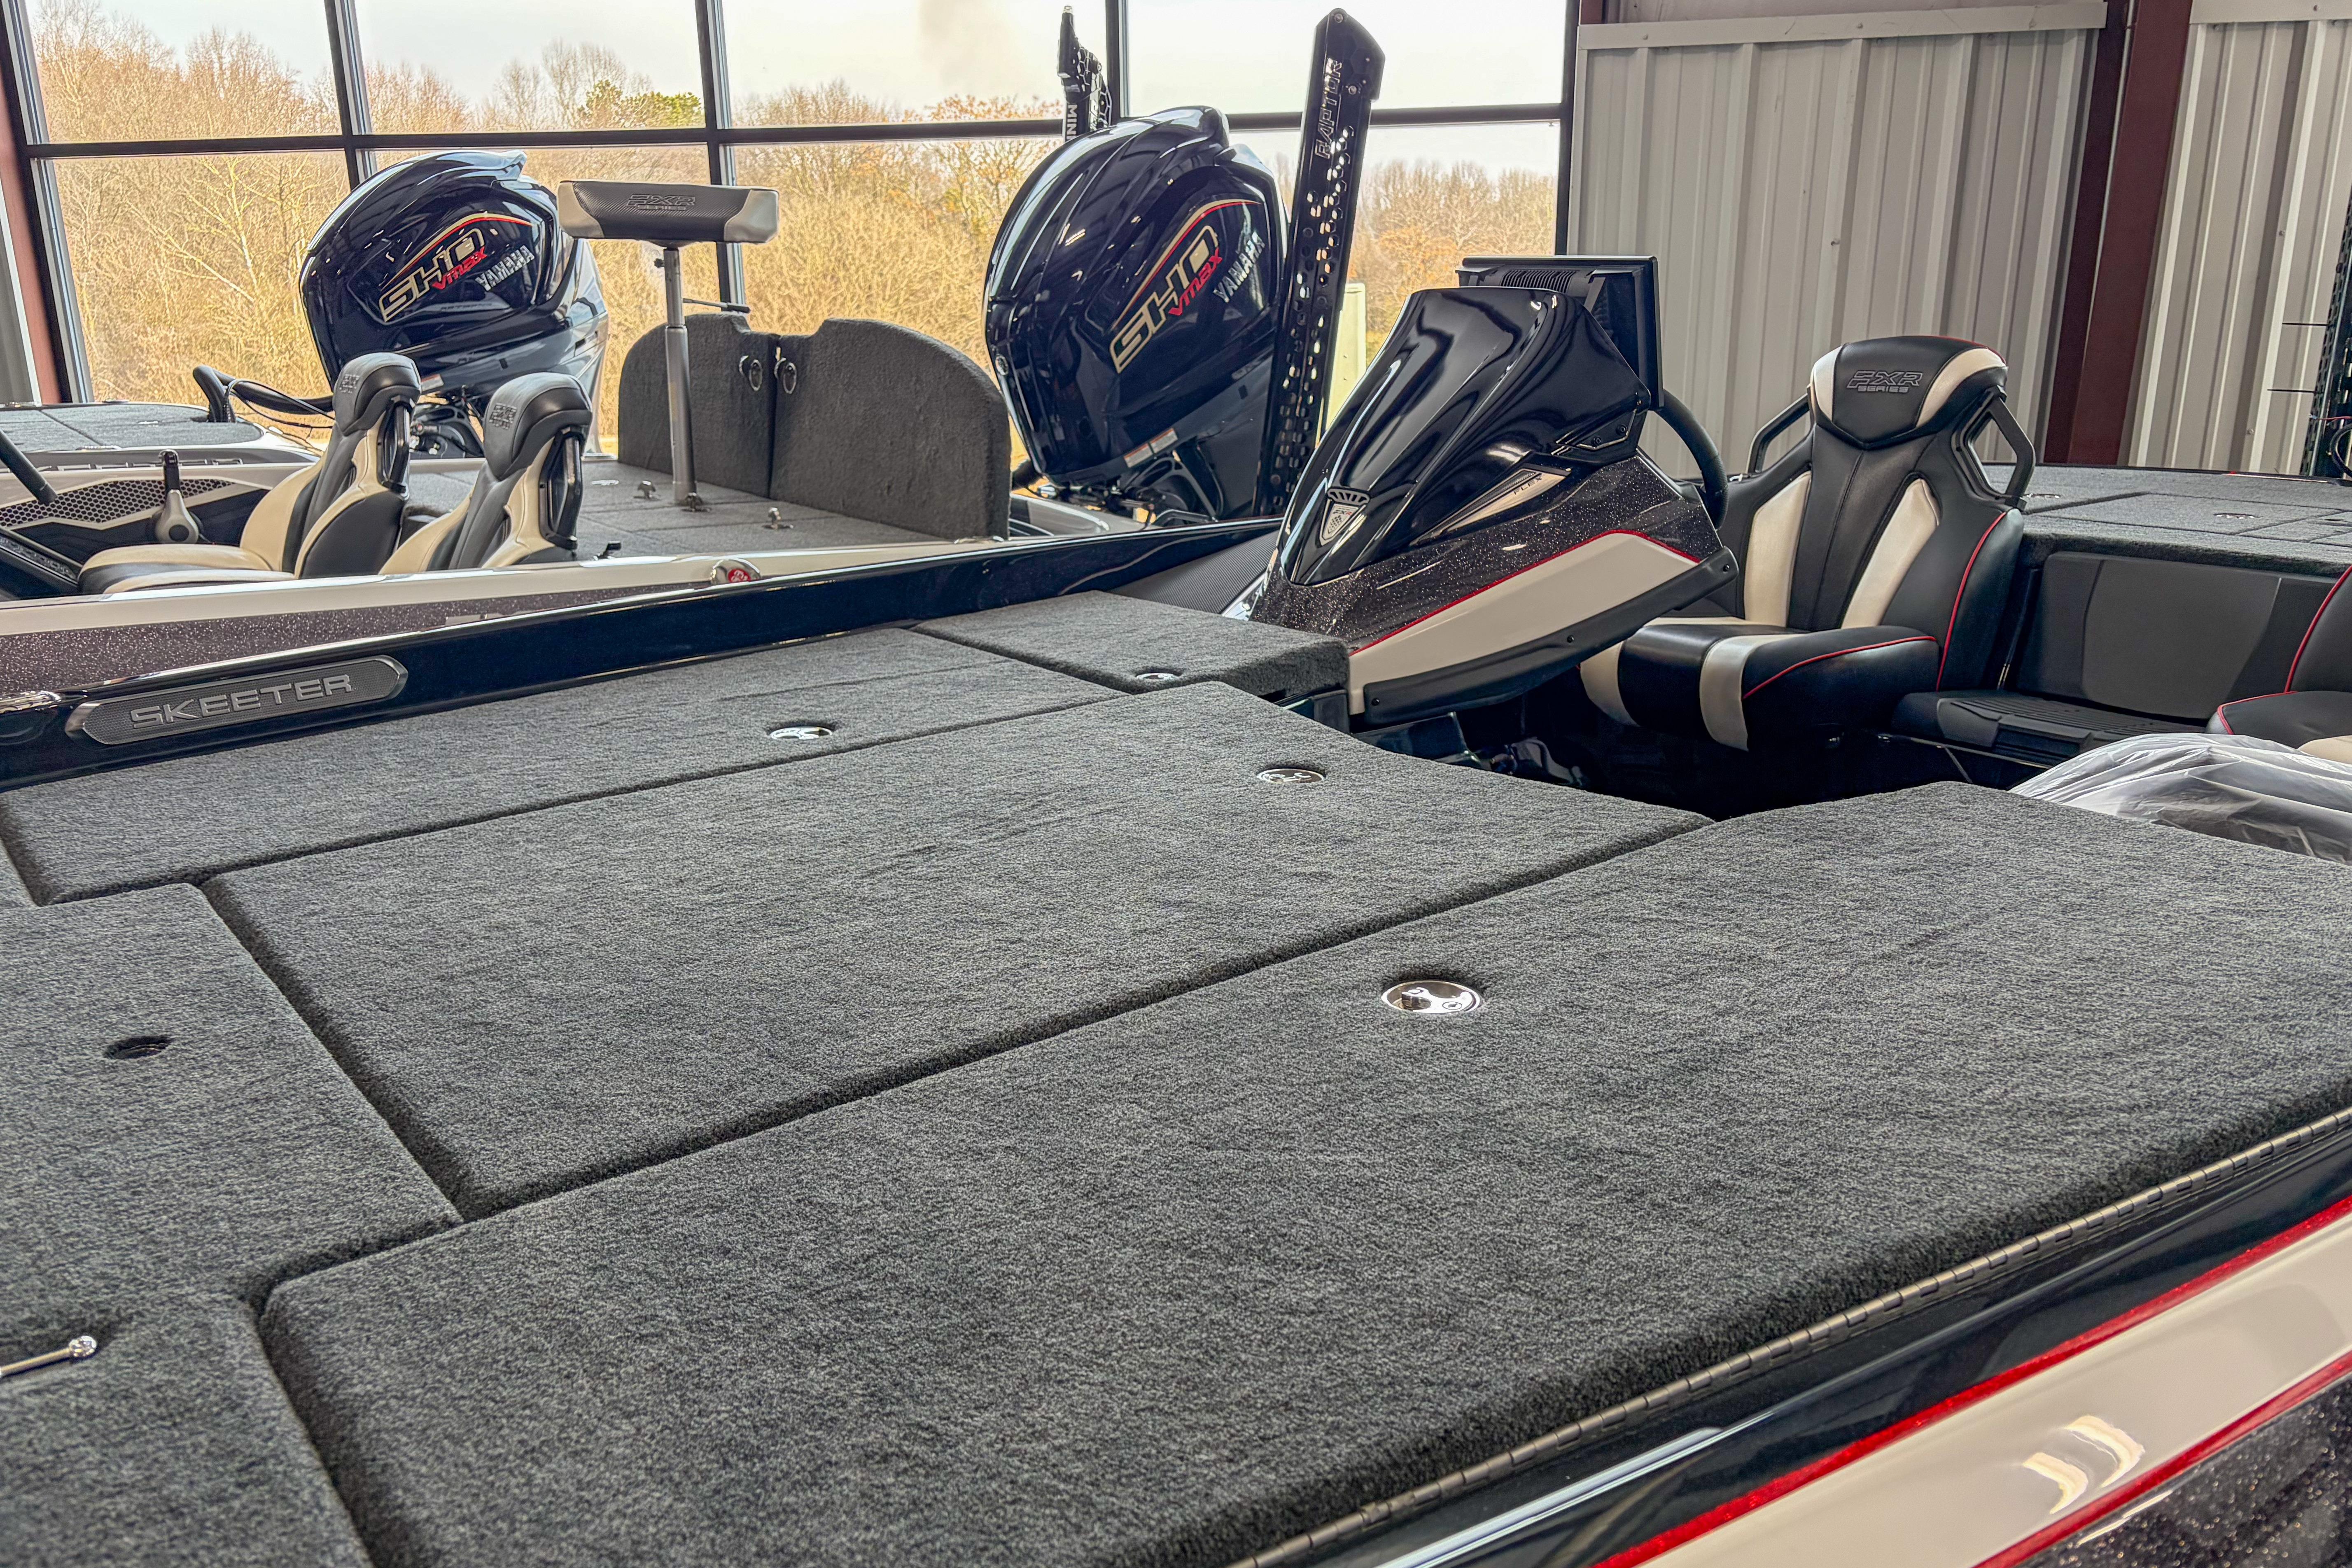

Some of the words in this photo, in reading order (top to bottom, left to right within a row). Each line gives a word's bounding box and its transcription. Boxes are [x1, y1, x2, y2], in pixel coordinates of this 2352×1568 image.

[1314, 58, 1342, 159] RAPTOR
[626, 194, 696, 207] FXR
[379, 228, 486, 322] SHO
[475, 245, 535, 292] YAMAHA
[1213, 231, 1265, 303] YAMAHA
[1109, 225, 1218, 373] SHO
[1846, 371, 1923, 388] FXR
[1514, 475, 1542, 495] FLEX
[131, 674, 354, 729] SKEETER
